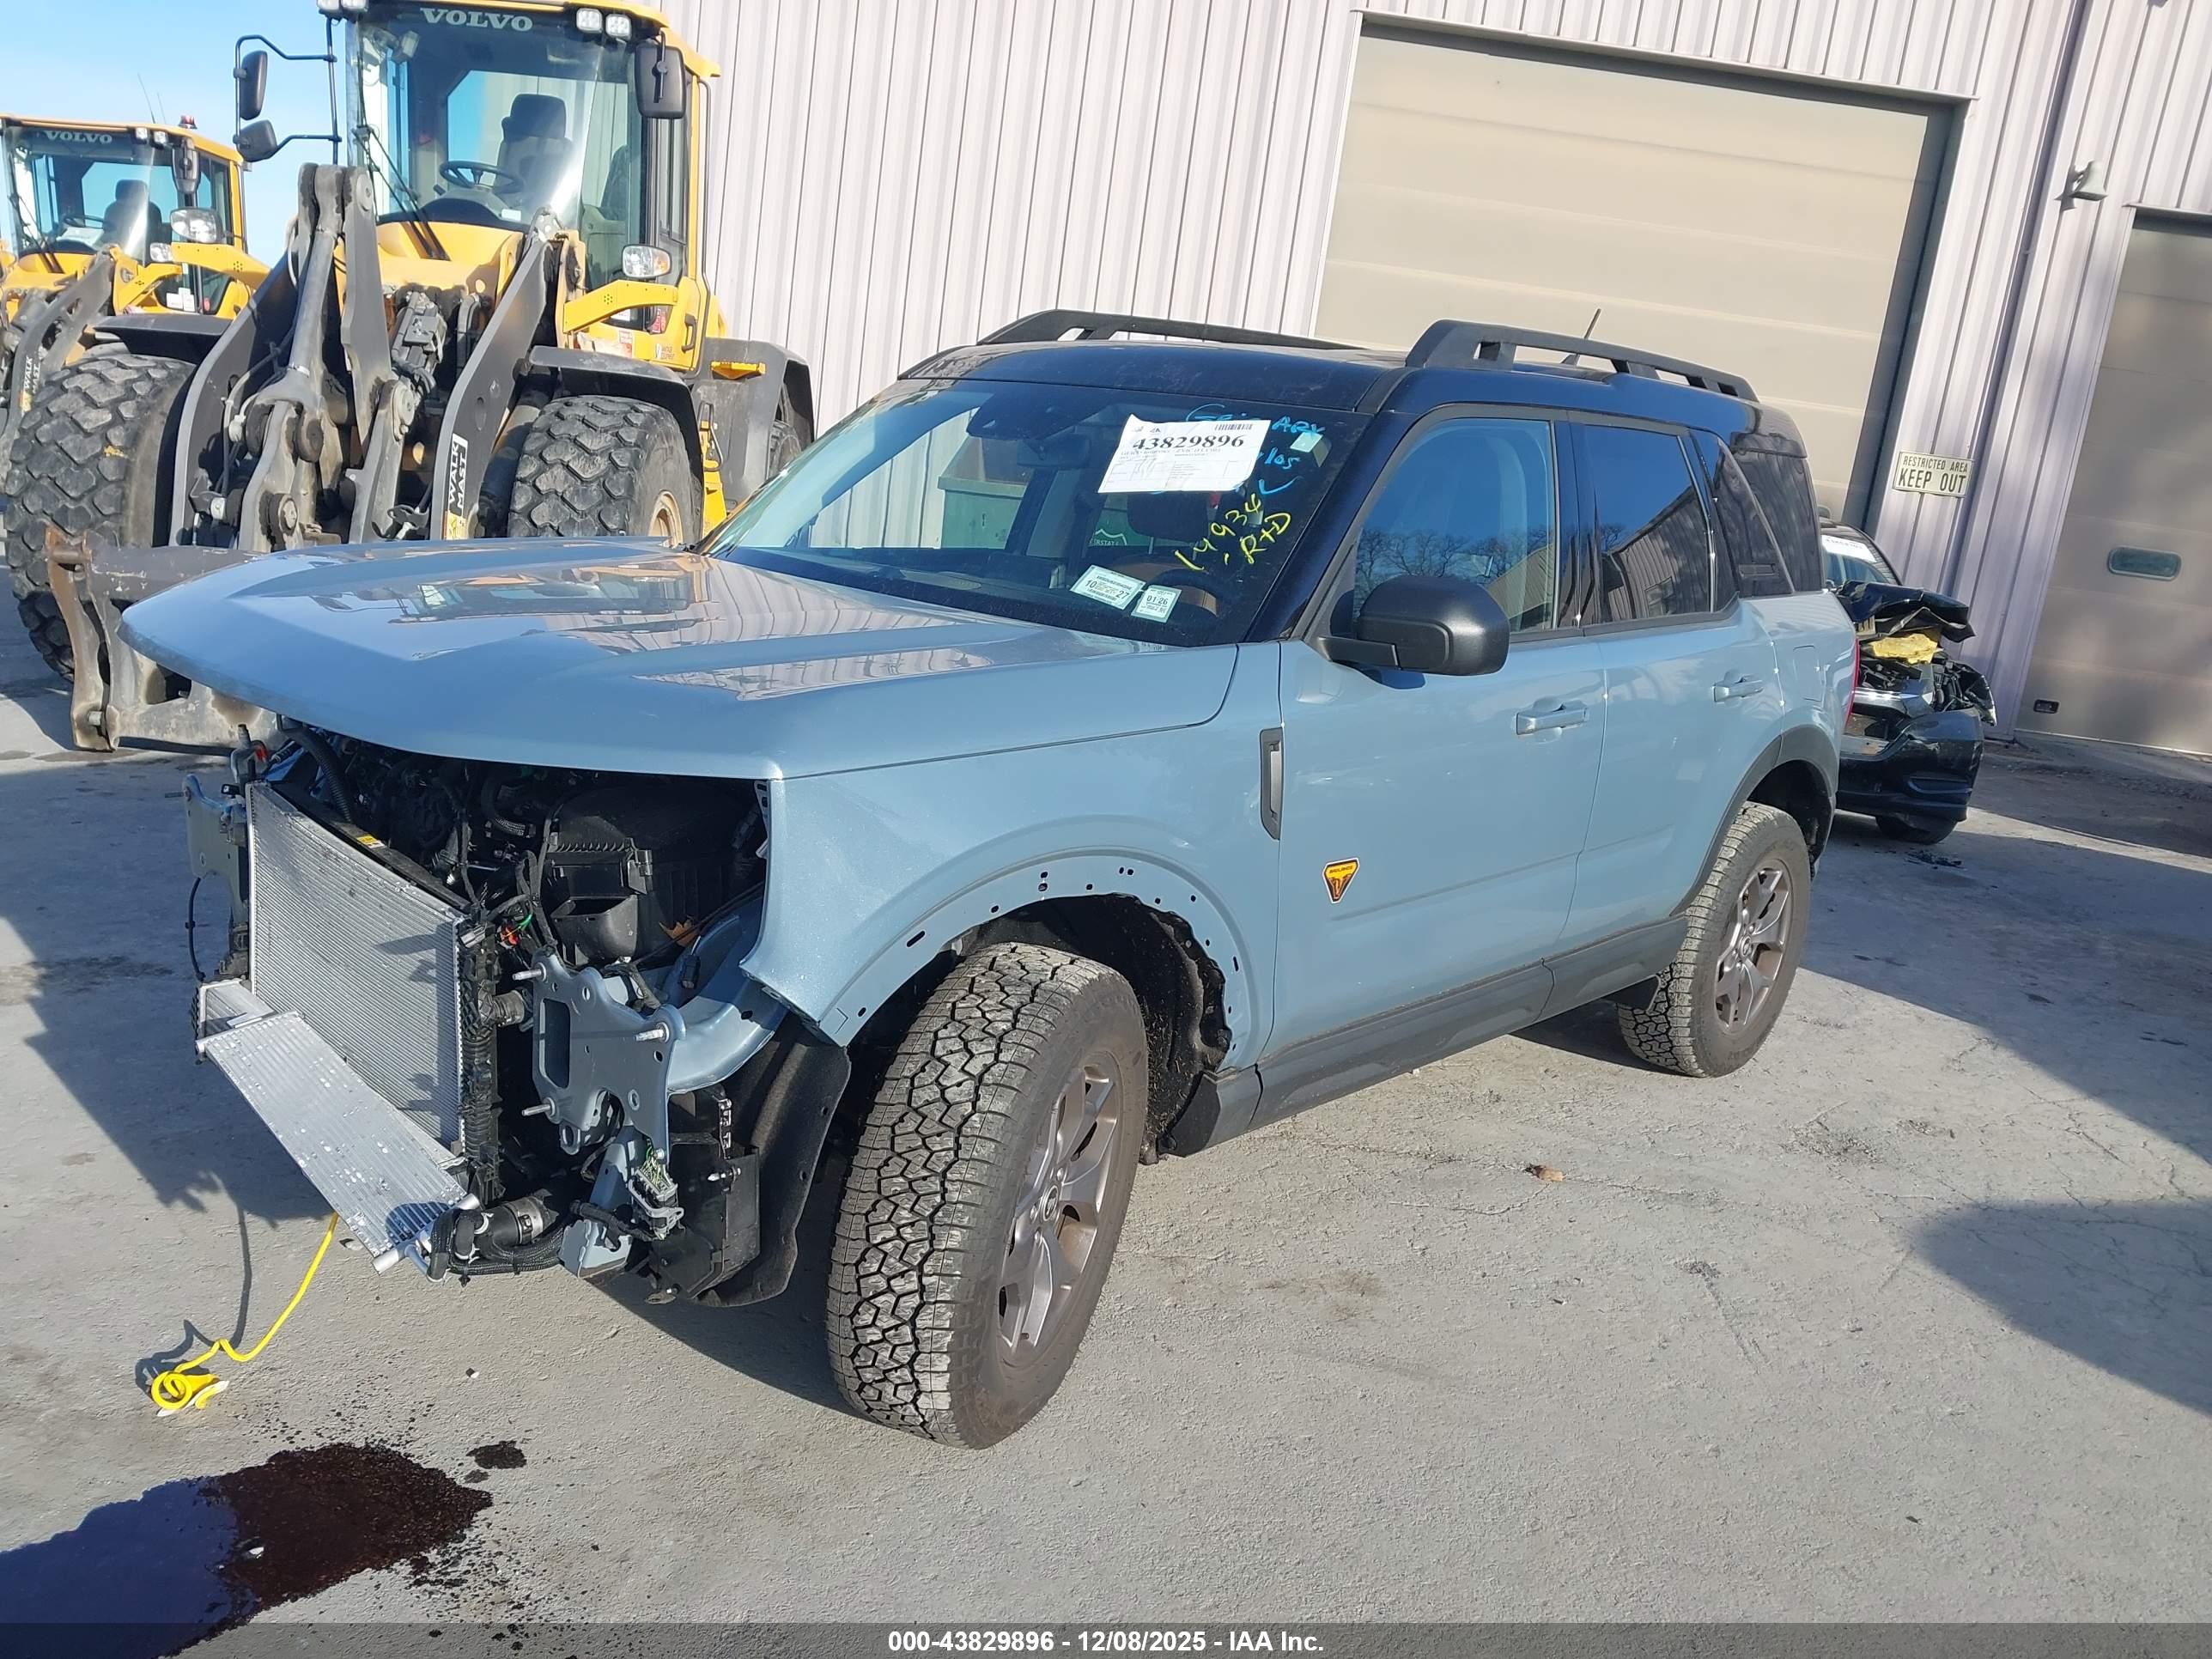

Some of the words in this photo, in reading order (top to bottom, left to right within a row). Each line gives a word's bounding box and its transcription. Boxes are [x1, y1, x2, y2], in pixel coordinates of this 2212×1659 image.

[420, 7, 533, 32] VOLVO
[44, 130, 112, 145] VOLVO
[1133, 434, 1246, 451] 43829896
[1903, 455, 1947, 471] RESTRICTED
[1950, 461, 1968, 472] AREA
[448, 441, 459, 504] WALK
[457, 452, 467, 509] MAST
[1898, 468, 1932, 489] KEEP
[1939, 473, 1967, 494] OUT
[1085, 579, 1097, 589] 10
[1115, 590, 1130, 599] 27
